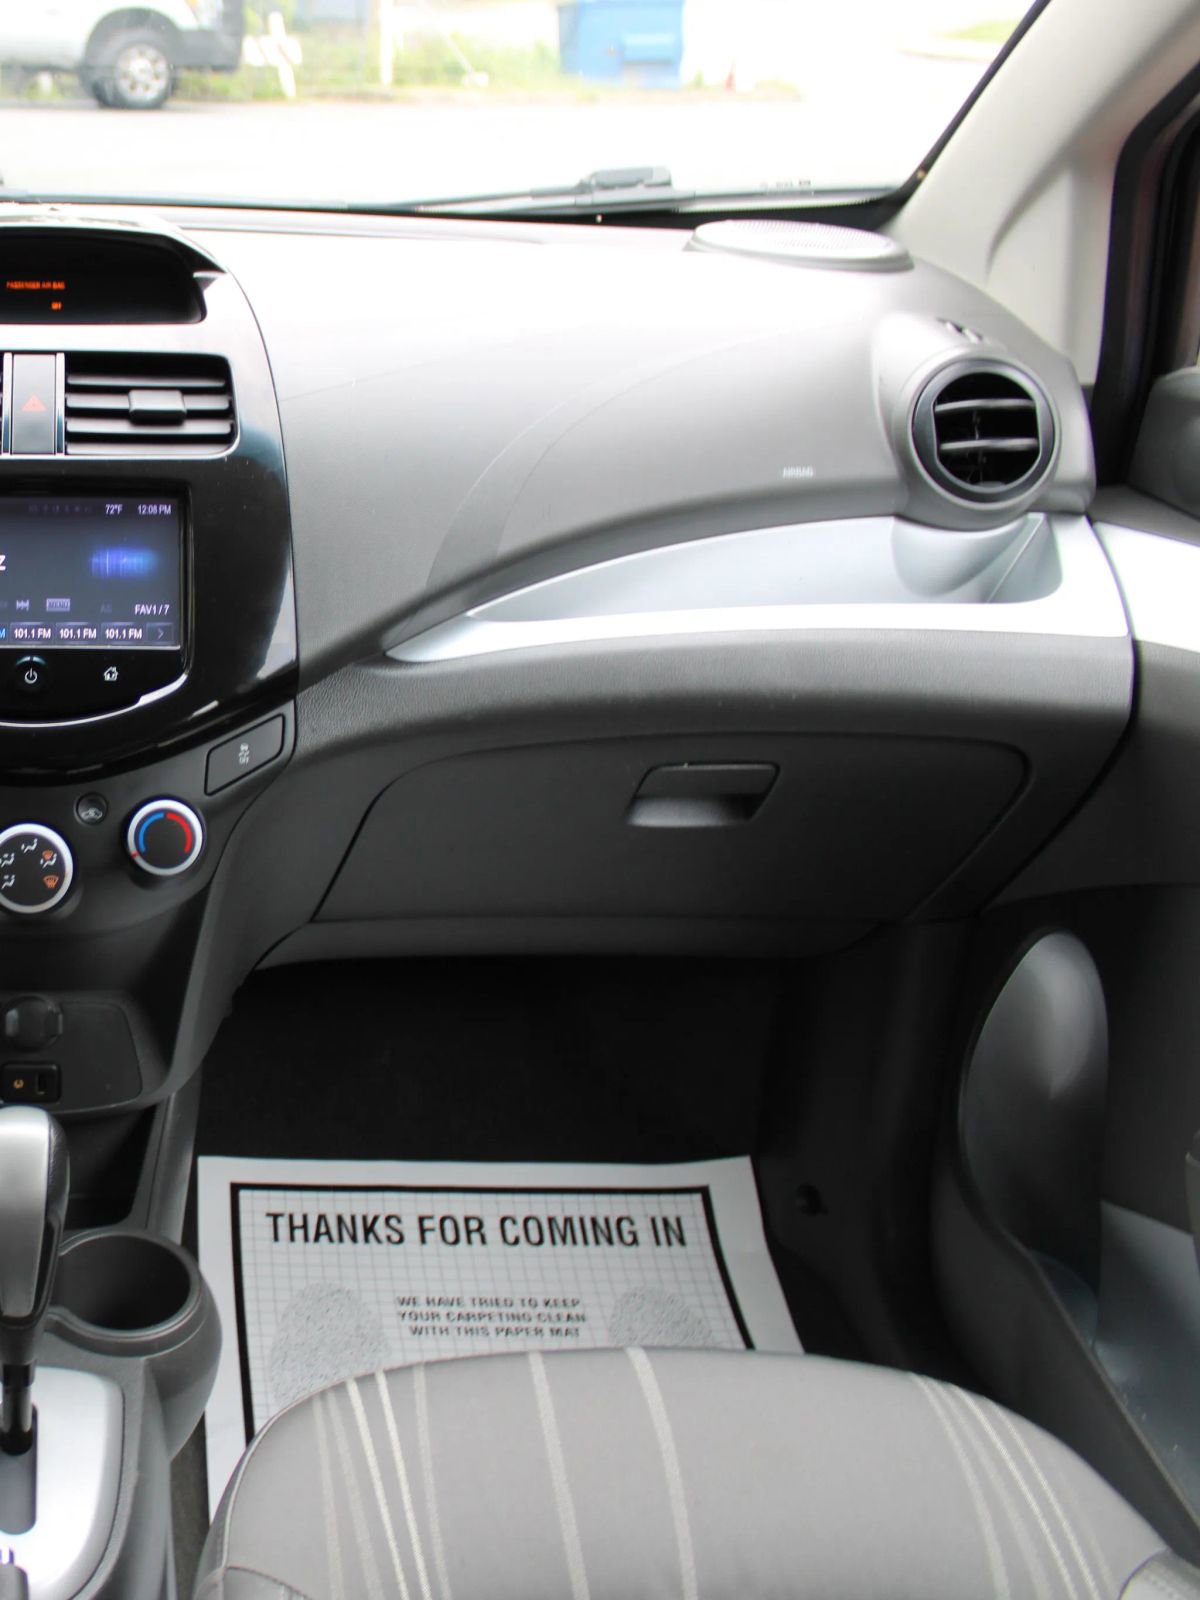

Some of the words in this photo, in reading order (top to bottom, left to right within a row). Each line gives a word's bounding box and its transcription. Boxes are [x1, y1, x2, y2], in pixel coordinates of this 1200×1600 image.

[158, 503, 172, 516] PM
[13, 627, 35, 639] 101.1
[37, 627, 51, 639] FM
[59, 627, 80, 639] 101.1
[82, 627, 97, 639] FM
[104, 627, 126, 639] 101.1
[127, 627, 143, 639] FM
[266, 1212, 405, 1246] THANKS
[418, 1214, 488, 1247] FOR
[499, 1215, 640, 1247] COMING
[650, 1216, 687, 1247] IN
[397, 1296, 417, 1307] WE
[426, 1296, 463, 1308] HAVE
[470, 1297, 513, 1308] TRIED
[520, 1297, 538, 1309] TO
[543, 1297, 579, 1308] KEEP
[398, 1310, 440, 1322] YOUR
[446, 1311, 533, 1323] CARPETING
[537, 1312, 585, 1323] CLEAN
[409, 1326, 449, 1337] WITH
[456, 1326, 490, 1337] THIS
[495, 1326, 544, 1338] PAPER
[549, 1327, 579, 1338] MAT
